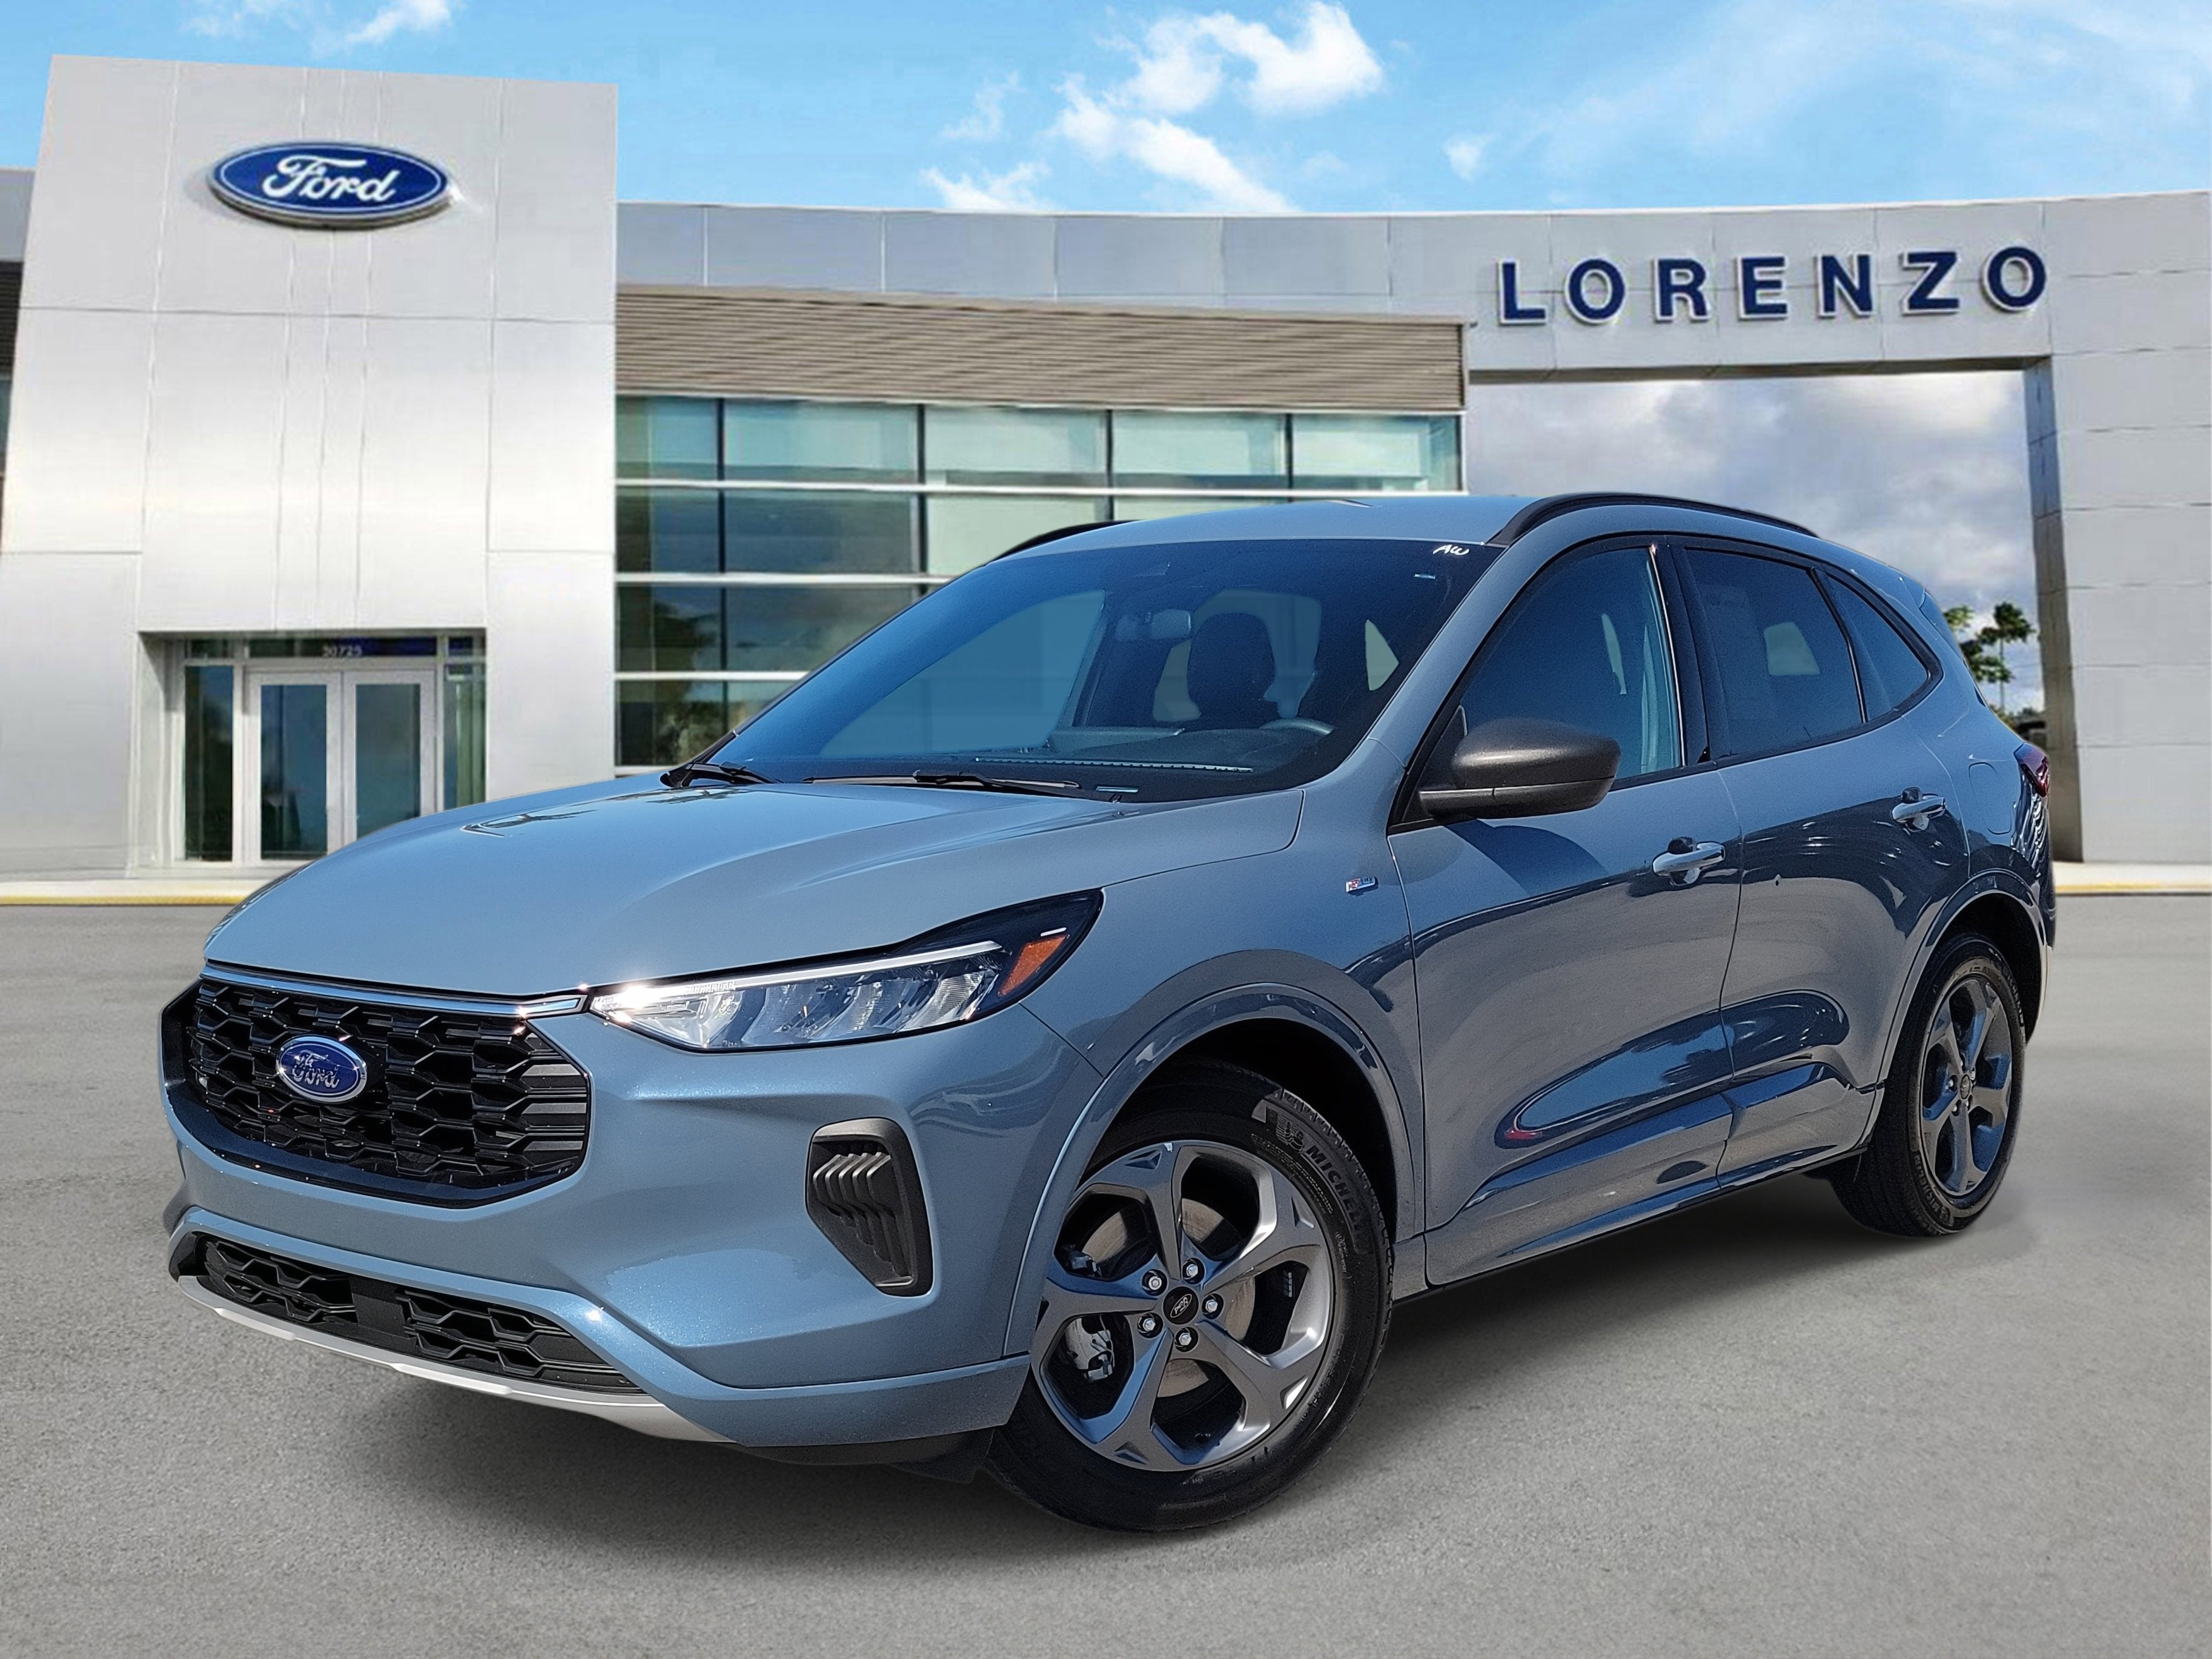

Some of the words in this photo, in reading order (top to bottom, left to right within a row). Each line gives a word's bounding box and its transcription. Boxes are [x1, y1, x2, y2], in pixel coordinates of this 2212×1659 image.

[262, 154, 400, 202] Ford
[1500, 246, 2047, 323] LORENZO
[292, 1049, 340, 1088] Ford
